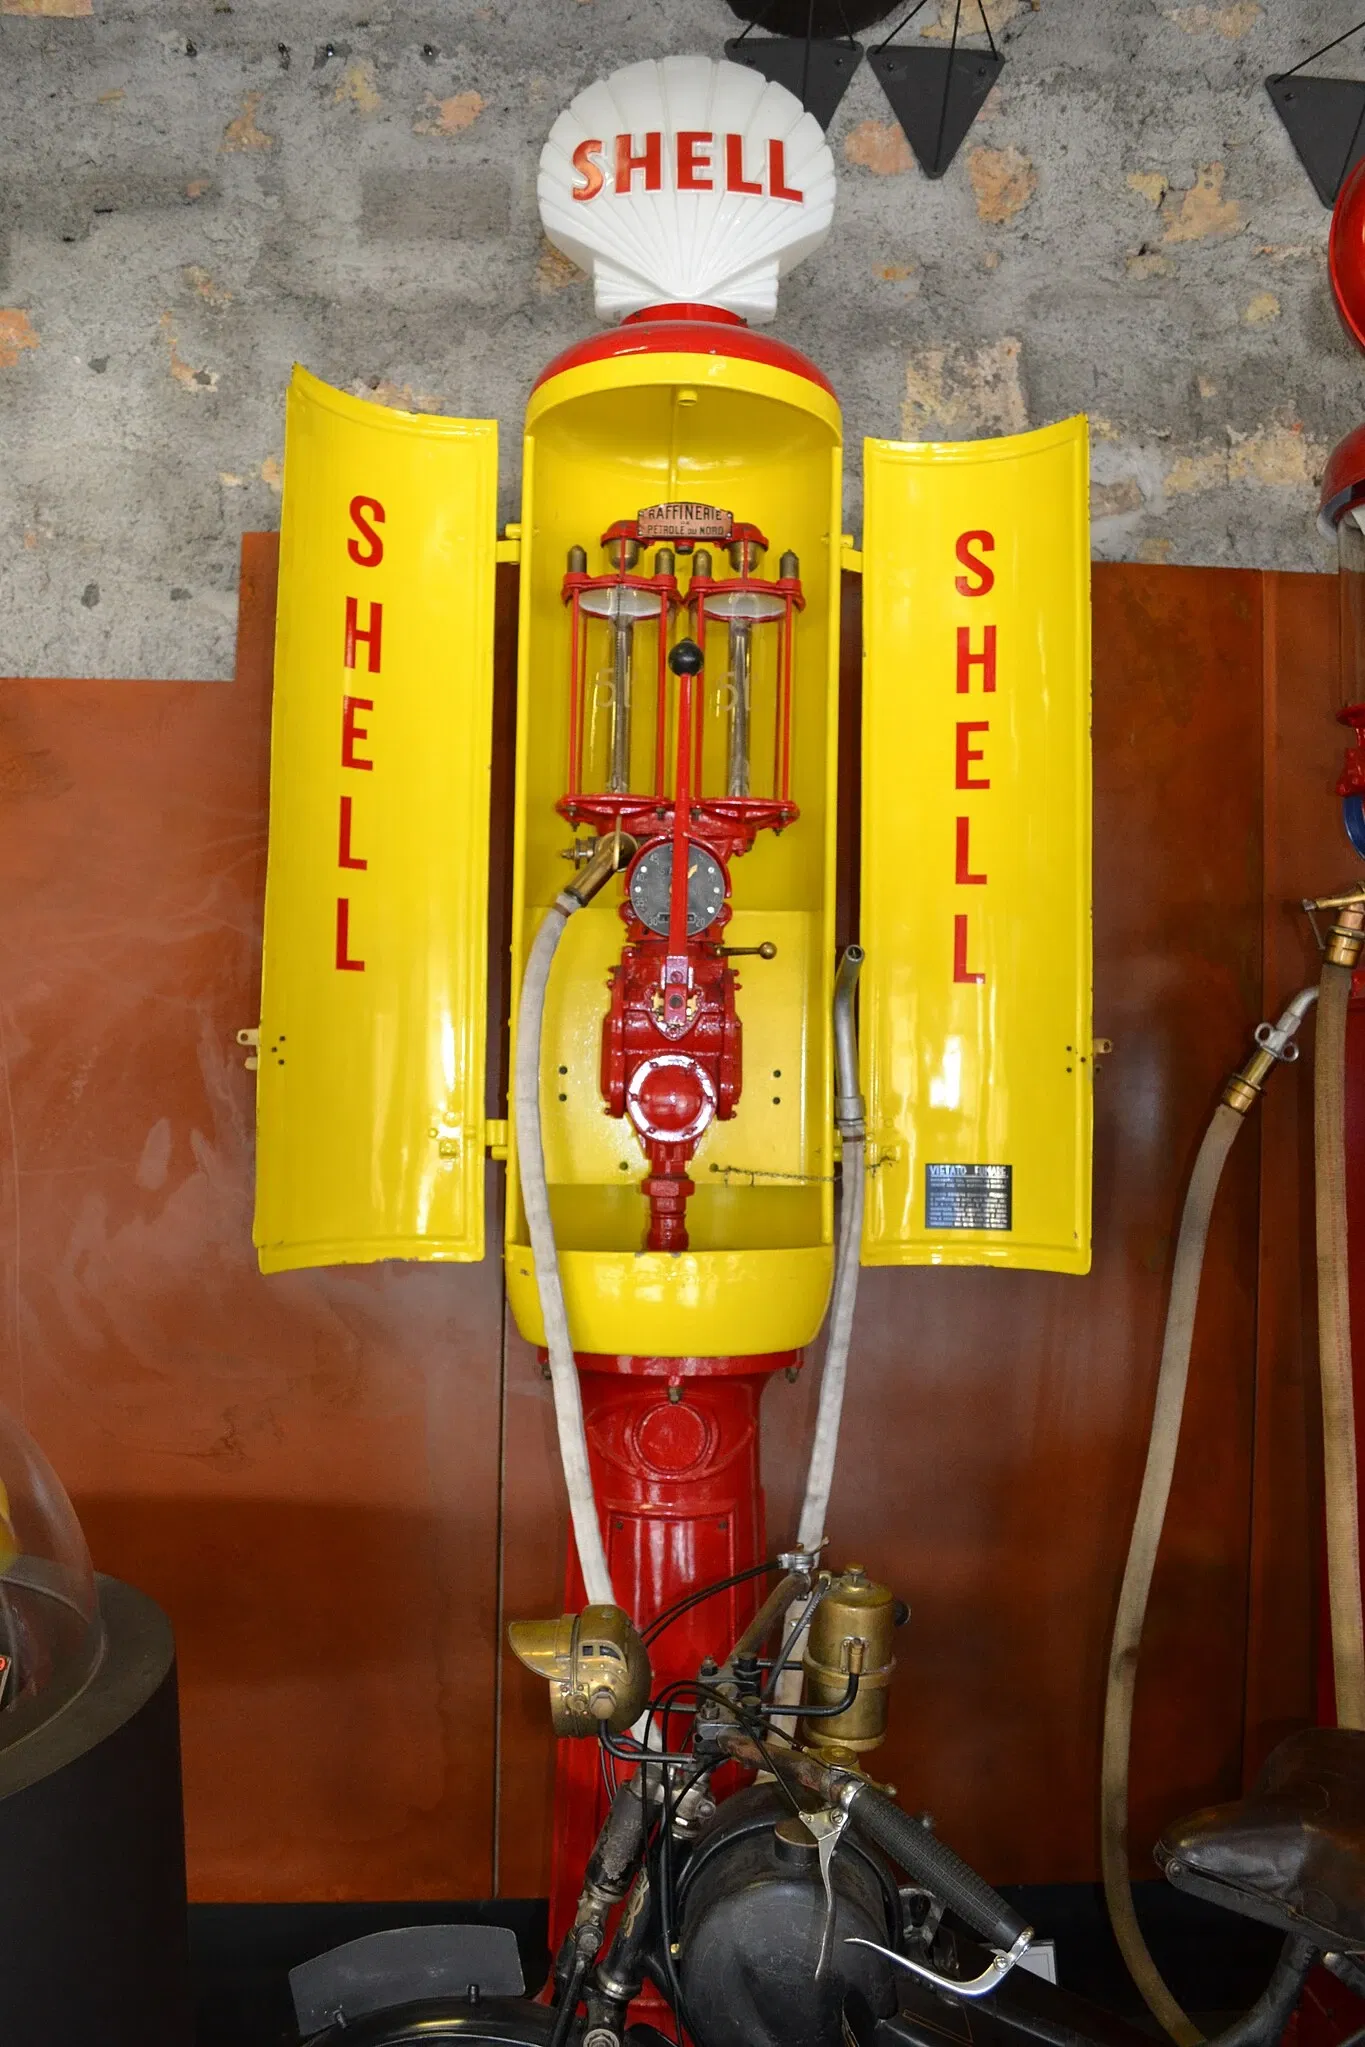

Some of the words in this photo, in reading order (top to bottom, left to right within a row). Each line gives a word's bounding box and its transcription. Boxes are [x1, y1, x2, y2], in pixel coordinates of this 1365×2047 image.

[572, 131, 804, 203] SHELL
[648, 505, 722, 521] RAFFINERIE
[699, 526, 724, 535] NORD
[335, 495, 386, 972] SHELL
[953, 530, 997, 983] SHELL
[930, 1165, 967, 1176] VIETATO
